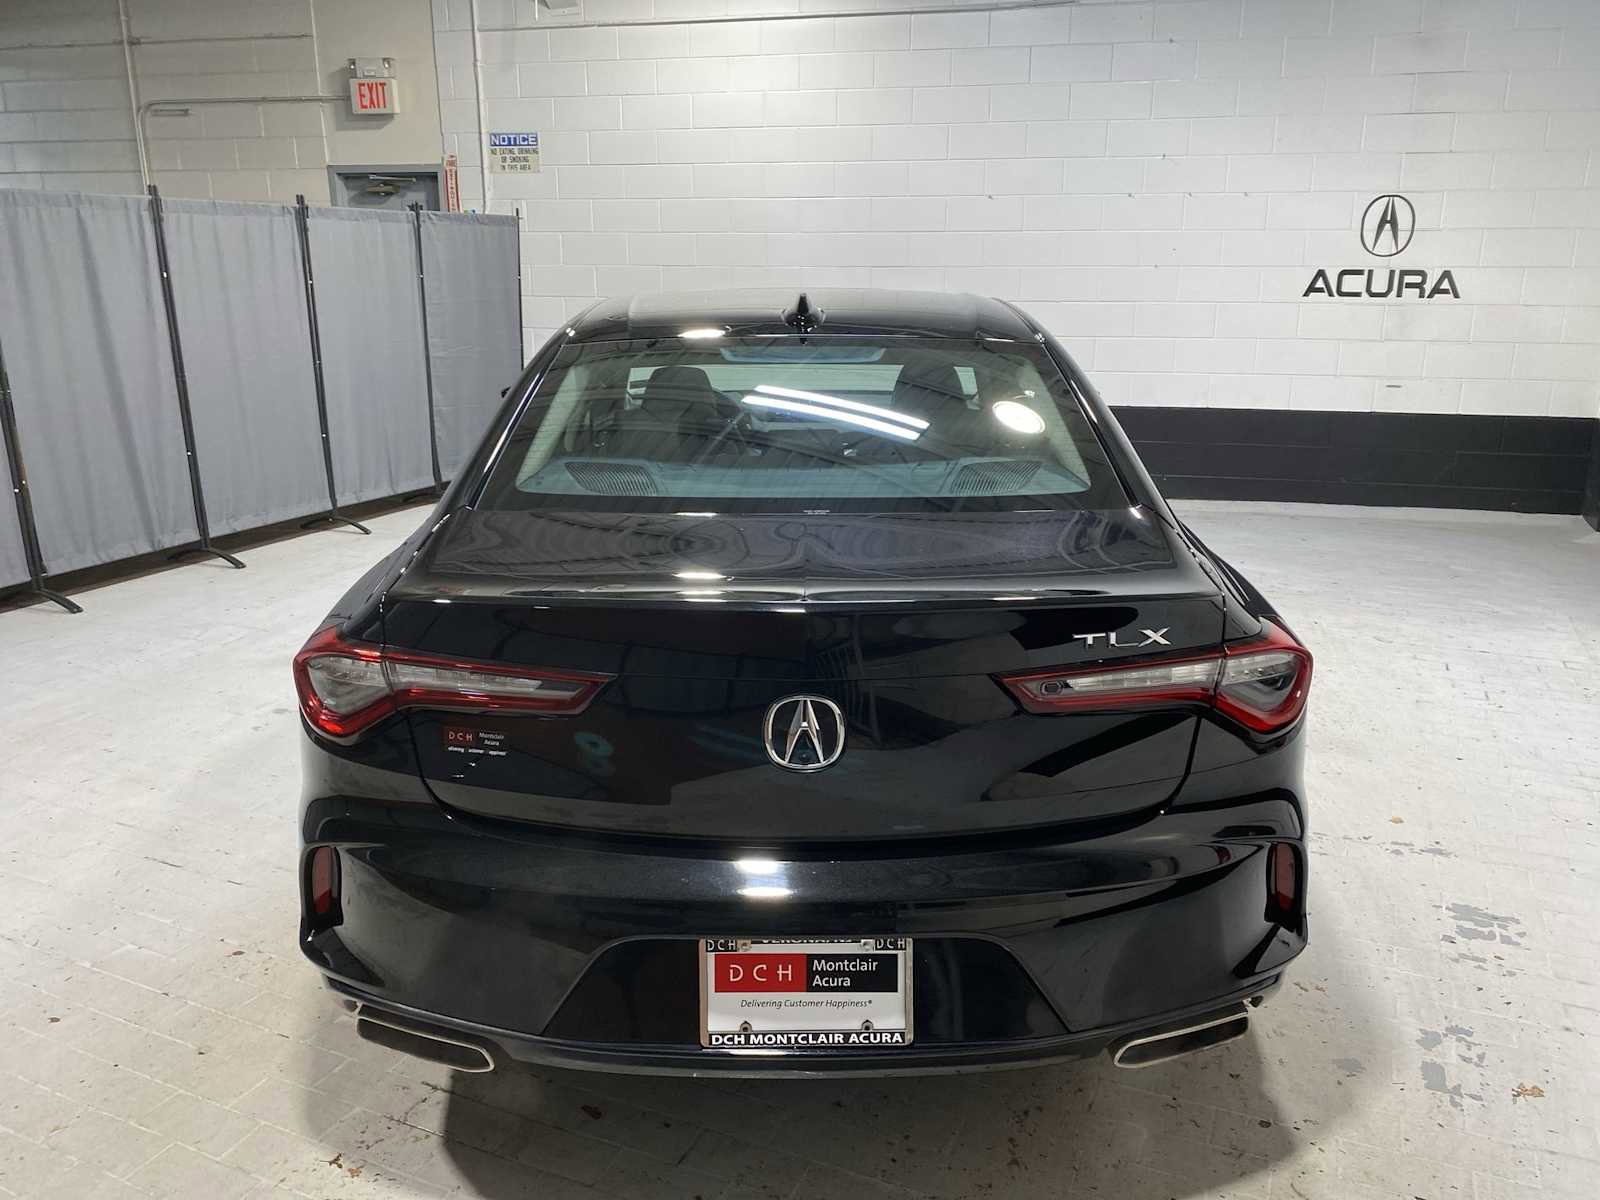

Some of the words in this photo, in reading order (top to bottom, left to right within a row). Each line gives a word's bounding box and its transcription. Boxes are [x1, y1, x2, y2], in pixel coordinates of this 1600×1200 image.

[358, 82, 386, 109] EXIT
[491, 134, 537, 146] NOTICE
[1302, 268, 1461, 299] ACURA
[1072, 626, 1171, 648] TLX
[812, 958, 879, 972] Montclair
[812, 974, 851, 987] Acura
[740, 999, 783, 1009] Delivering
[784, 999, 825, 1008] Customer
[711, 1034, 745, 1045] DCH
[749, 1033, 844, 1045] MONTCLAIR
[848, 1032, 903, 1044] ACURA
